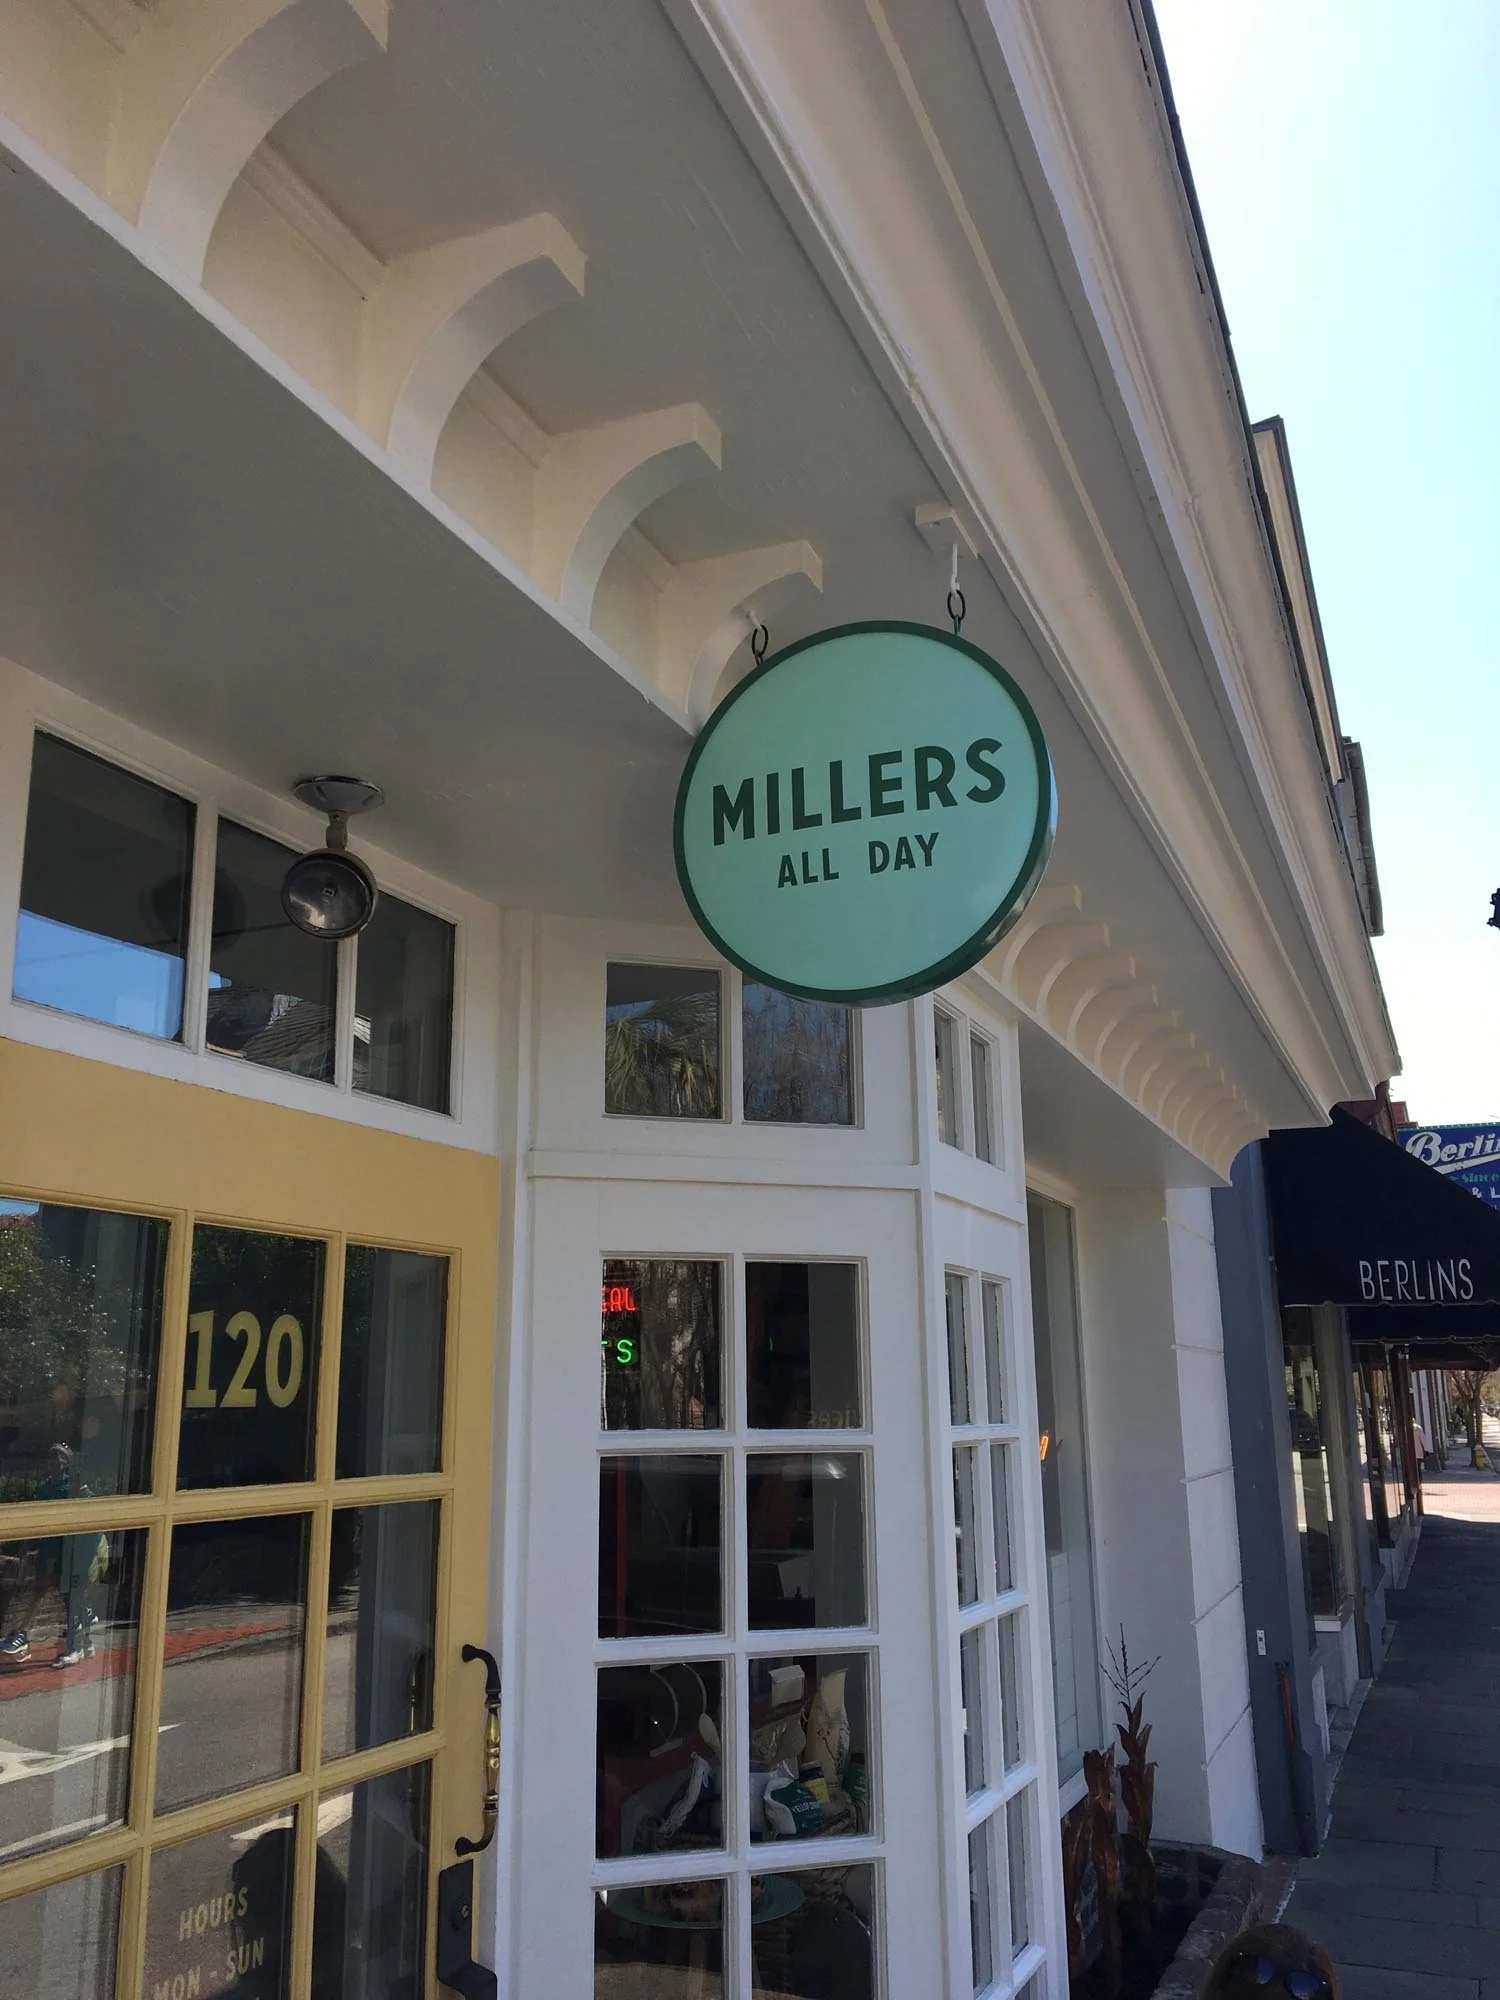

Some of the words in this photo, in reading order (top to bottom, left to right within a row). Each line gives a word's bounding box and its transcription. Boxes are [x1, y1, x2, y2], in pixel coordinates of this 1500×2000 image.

[713, 737, 1006, 846] MILLERS
[777, 847, 839, 888] ALL
[868, 832, 940, 874] DAY
[1405, 1130, 1500, 1166] Berli
[1359, 1258, 1474, 1301] BERLINS
[185, 1309, 304, 1409] 120
[178, 1886, 248, 1942] HOURS
[225, 1937, 265, 1982] SUN
